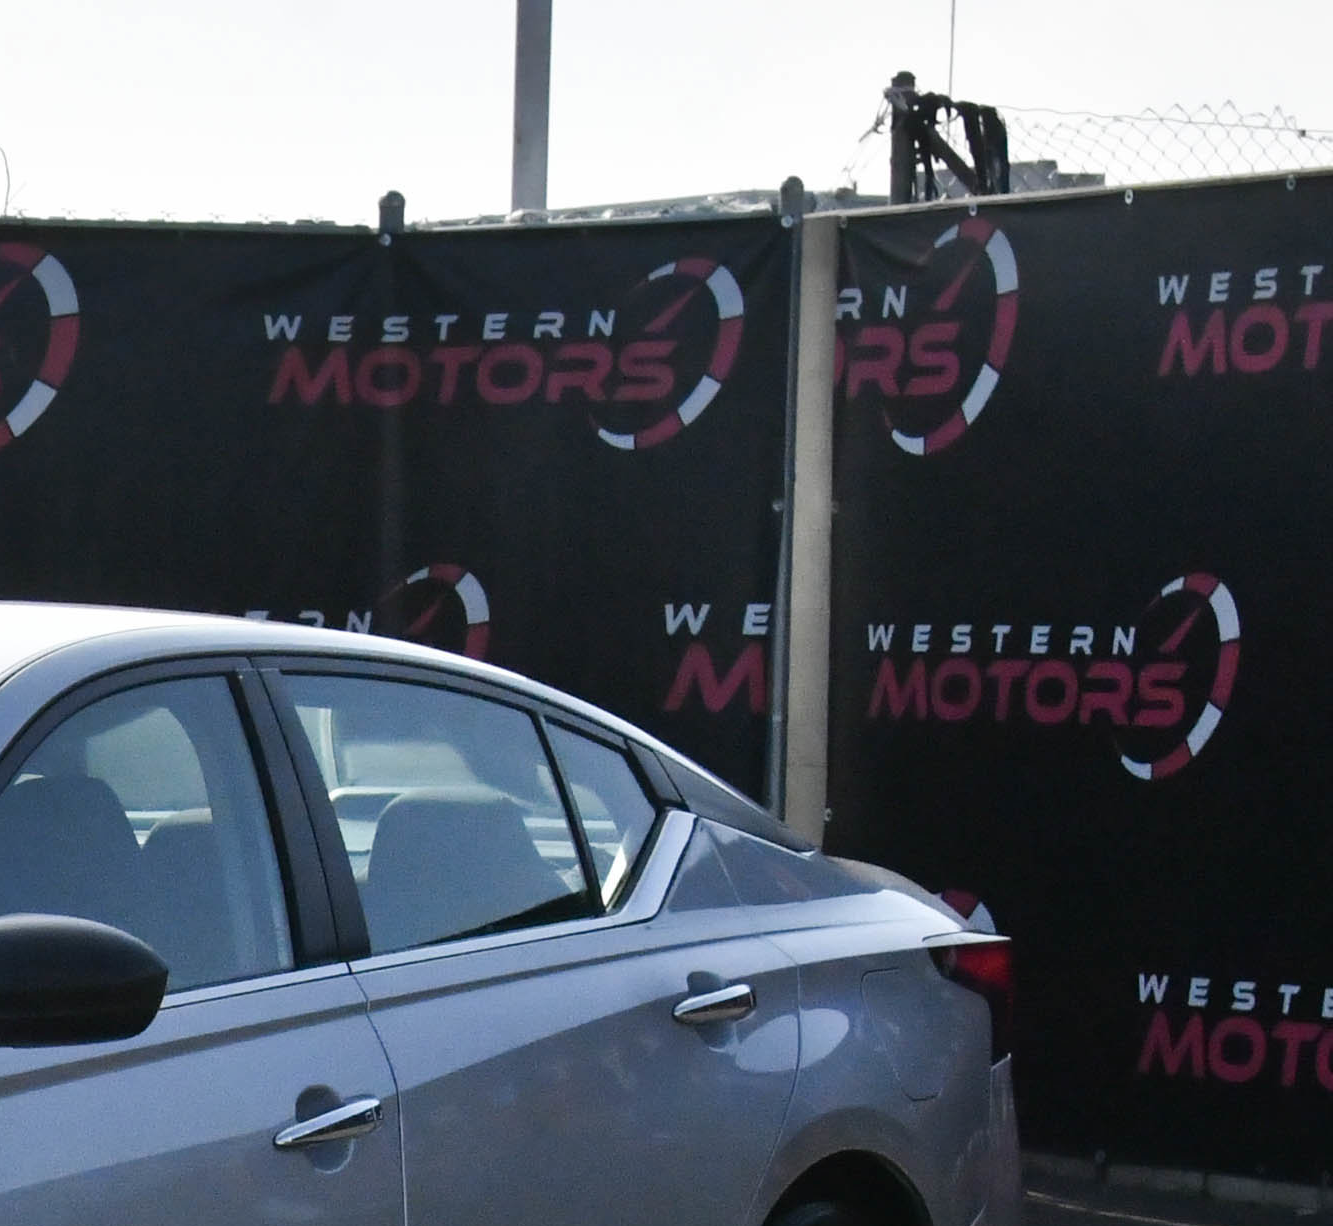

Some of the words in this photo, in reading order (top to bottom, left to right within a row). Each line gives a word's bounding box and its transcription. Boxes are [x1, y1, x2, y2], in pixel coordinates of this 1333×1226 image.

[263, 309, 616, 342] WESTERN
[267, 341, 677, 406] MOTORS
[867, 623, 1137, 656] WESTERN
[866, 657, 1188, 728] MOTORS
